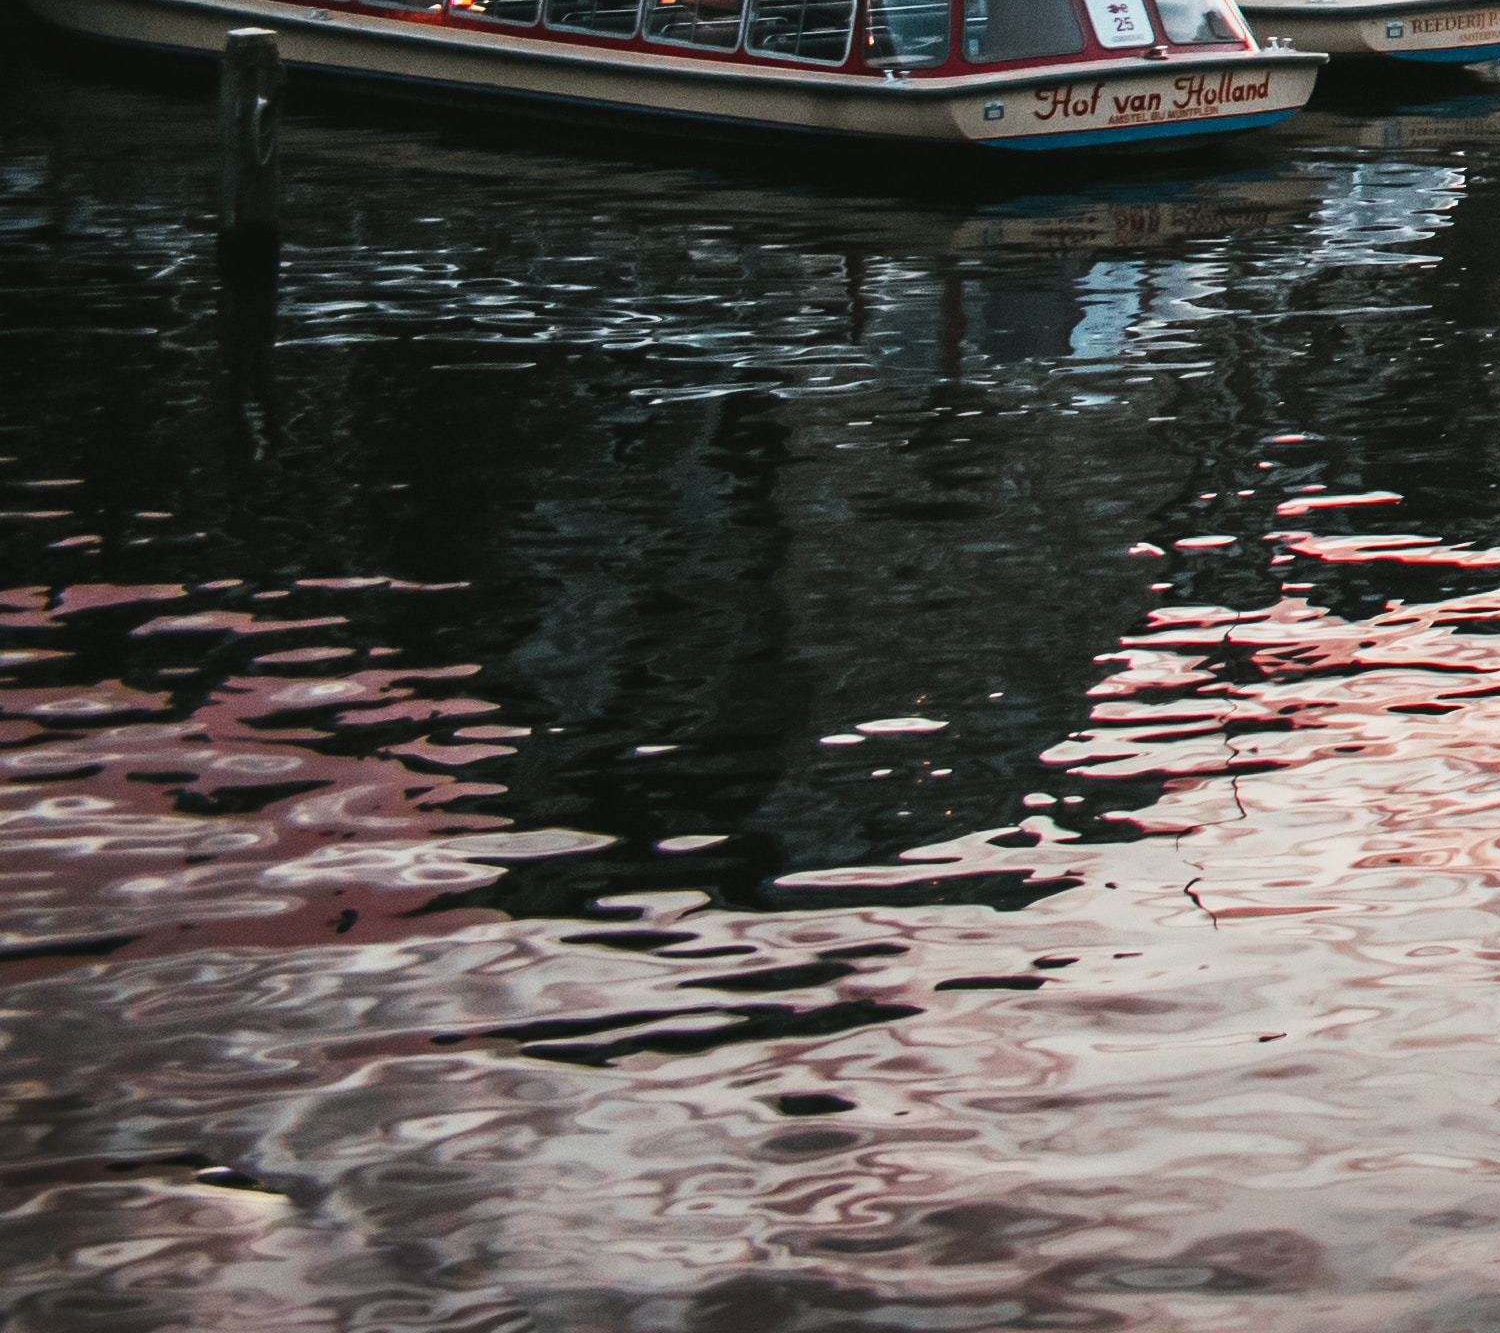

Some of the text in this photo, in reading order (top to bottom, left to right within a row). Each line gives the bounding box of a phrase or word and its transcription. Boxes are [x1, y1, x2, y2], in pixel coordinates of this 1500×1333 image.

[1114, 16, 1135, 32] 25
[1411, 13, 1485, 34] REEDERIJ
[1034, 69, 1271, 121] Hof van Holland
[1107, 112, 1148, 125] AMSTEL
